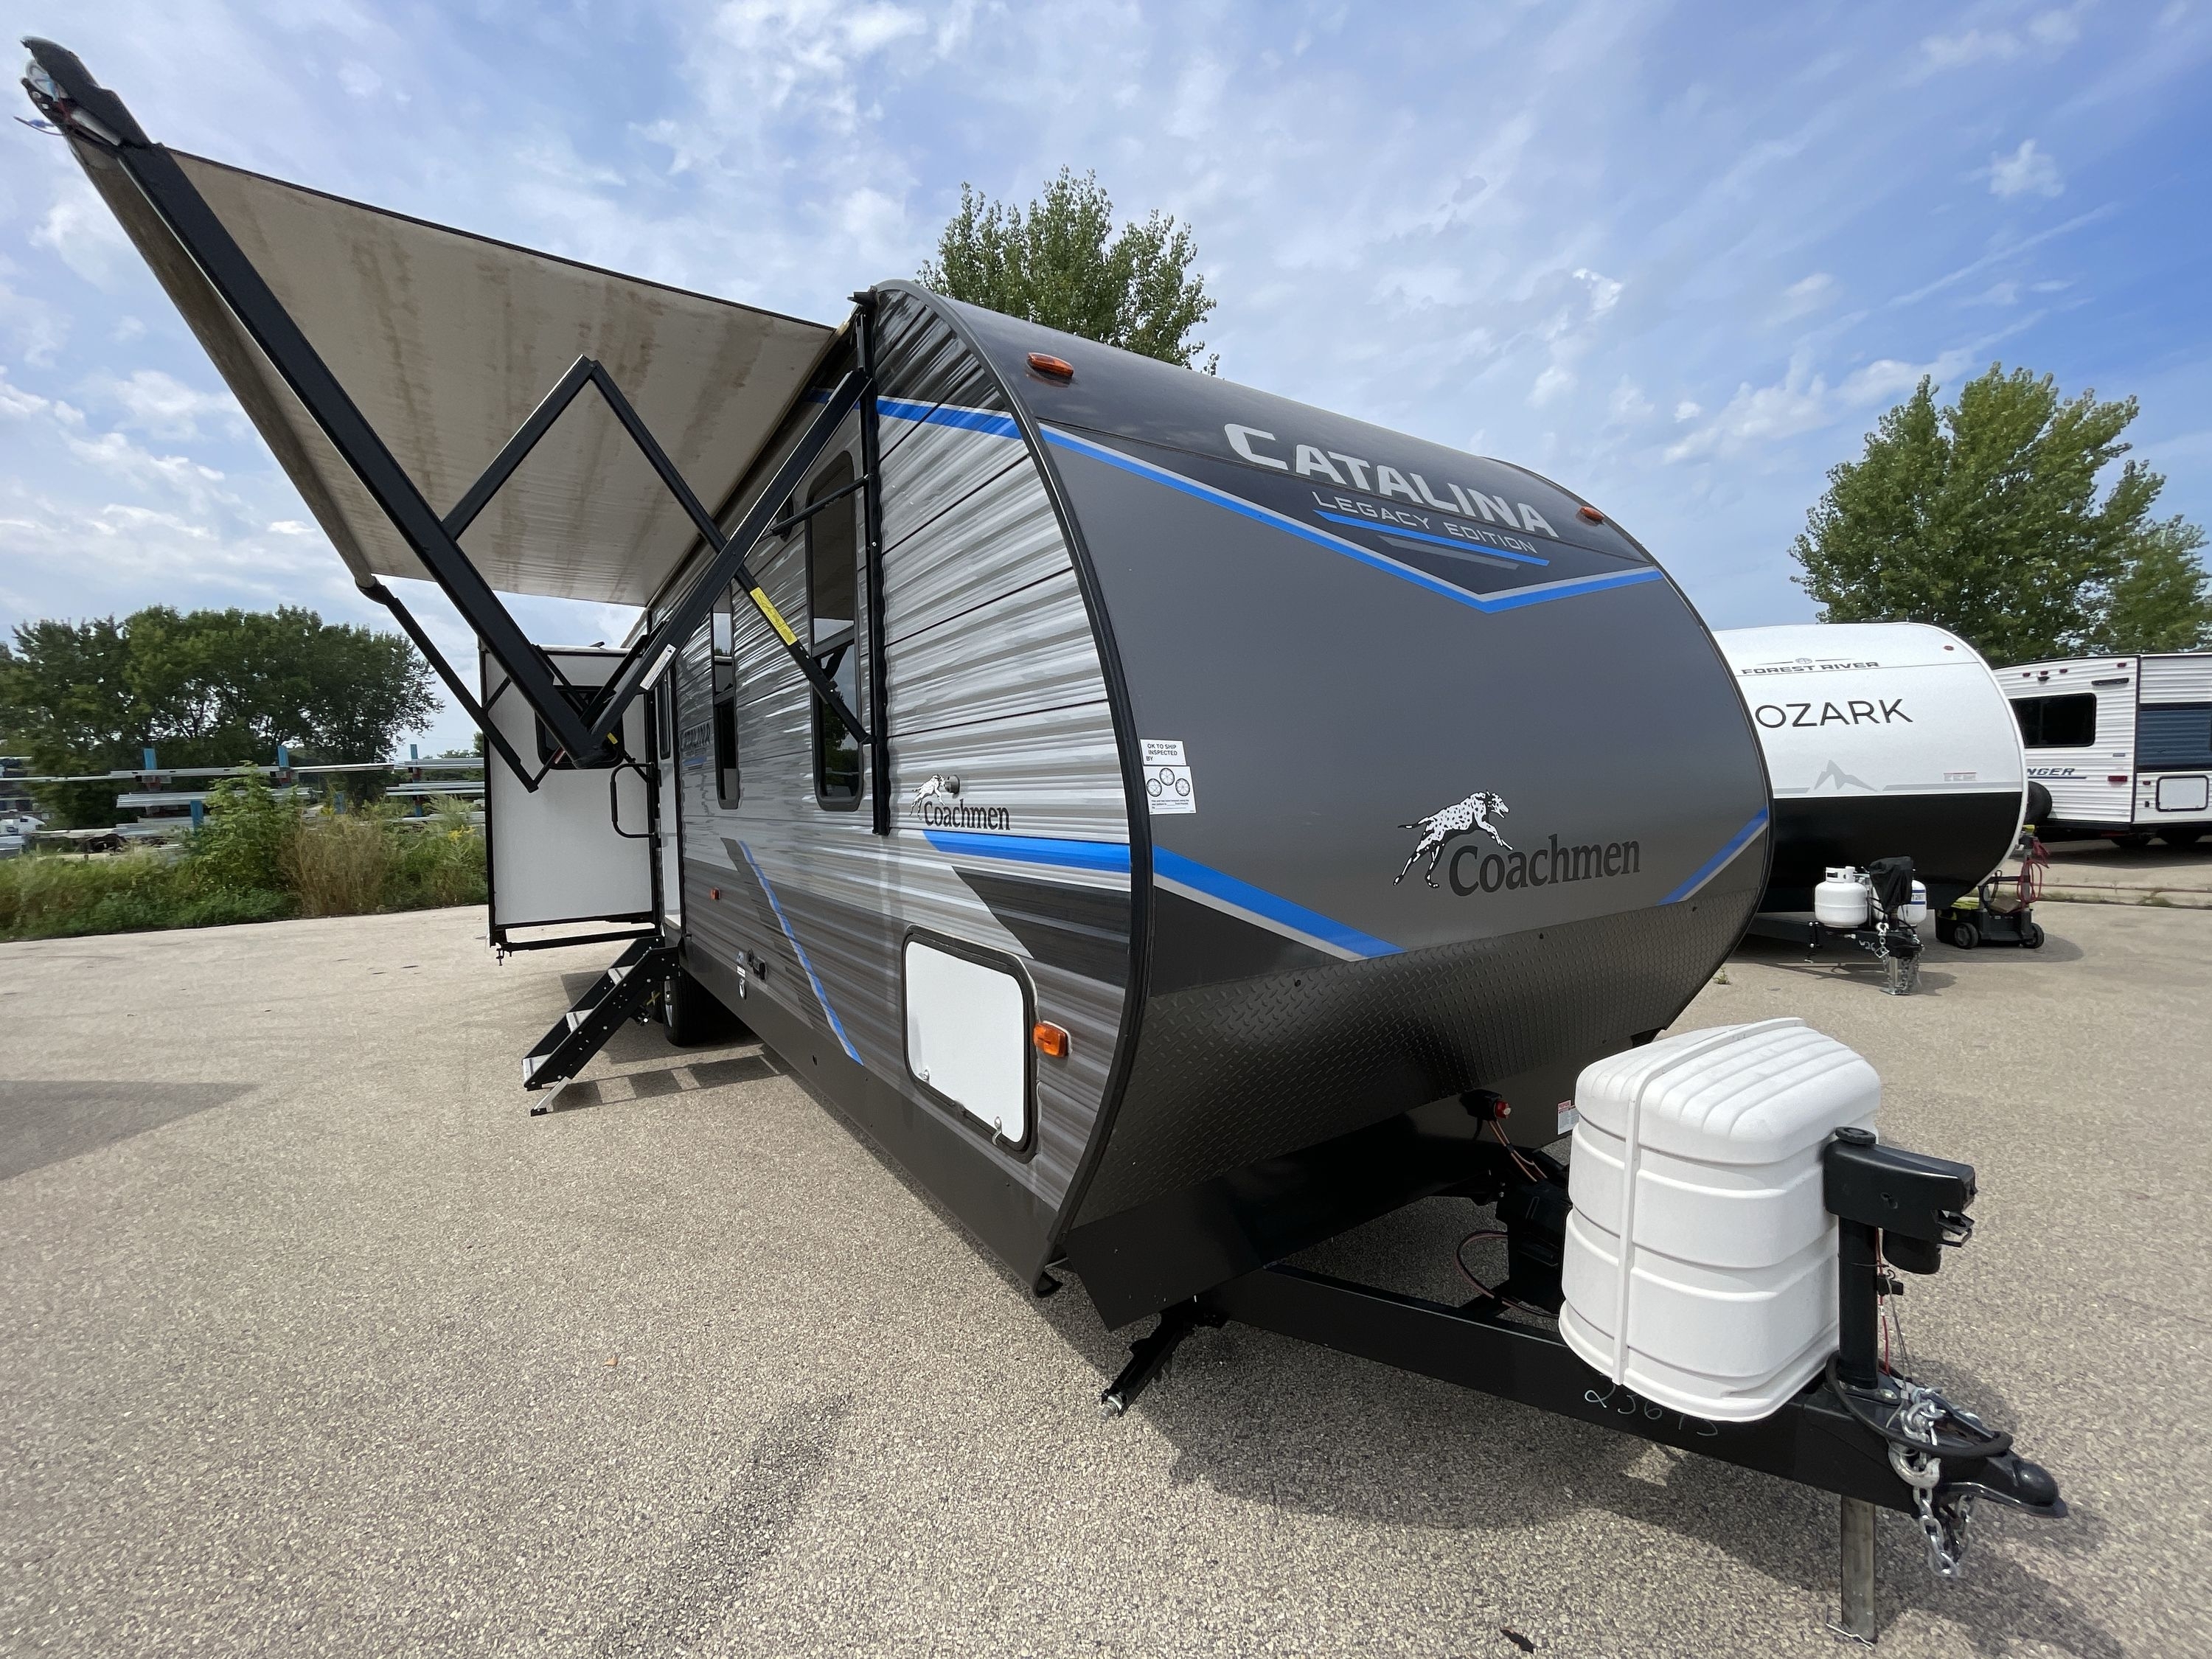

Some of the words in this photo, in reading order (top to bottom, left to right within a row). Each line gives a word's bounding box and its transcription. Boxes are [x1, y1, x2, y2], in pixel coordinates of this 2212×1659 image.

[1224, 423, 1559, 538] CATALINA
[1312, 491, 1430, 529] LEGACY
[1443, 521, 1537, 554] EDITION
[1742, 665, 1815, 675] FOREST
[1819, 661, 1880, 671] RIVER
[1756, 698, 1913, 728] OZARK
[924, 798, 1010, 830] Coachmen
[1449, 833, 1641, 897] Coachmen
